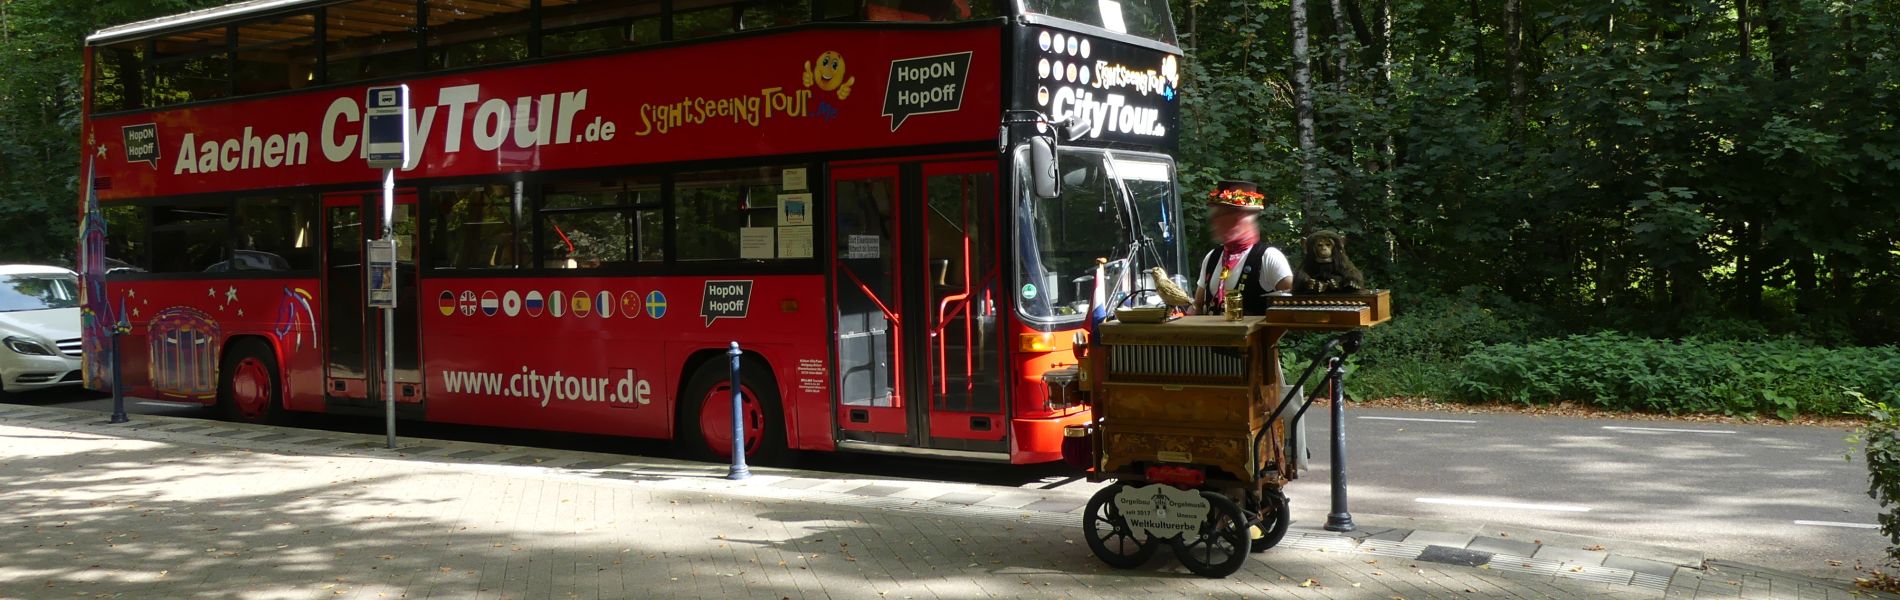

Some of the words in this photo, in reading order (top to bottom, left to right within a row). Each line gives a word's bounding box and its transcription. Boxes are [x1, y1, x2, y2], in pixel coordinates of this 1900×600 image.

[898, 61, 955, 84] HopON
[898, 84, 956, 108] HopOff
[129, 128, 154, 142] HopON
[174, 126, 309, 175] Aachen
[321, 84, 616, 171] CyTour.de
[129, 142, 154, 156] HopOff
[709, 285, 744, 298] HopON
[710, 300, 744, 314] HopOff
[443, 365, 650, 407] www.citytour.de
[1130, 518, 1196, 531] Weltkulturerbe
